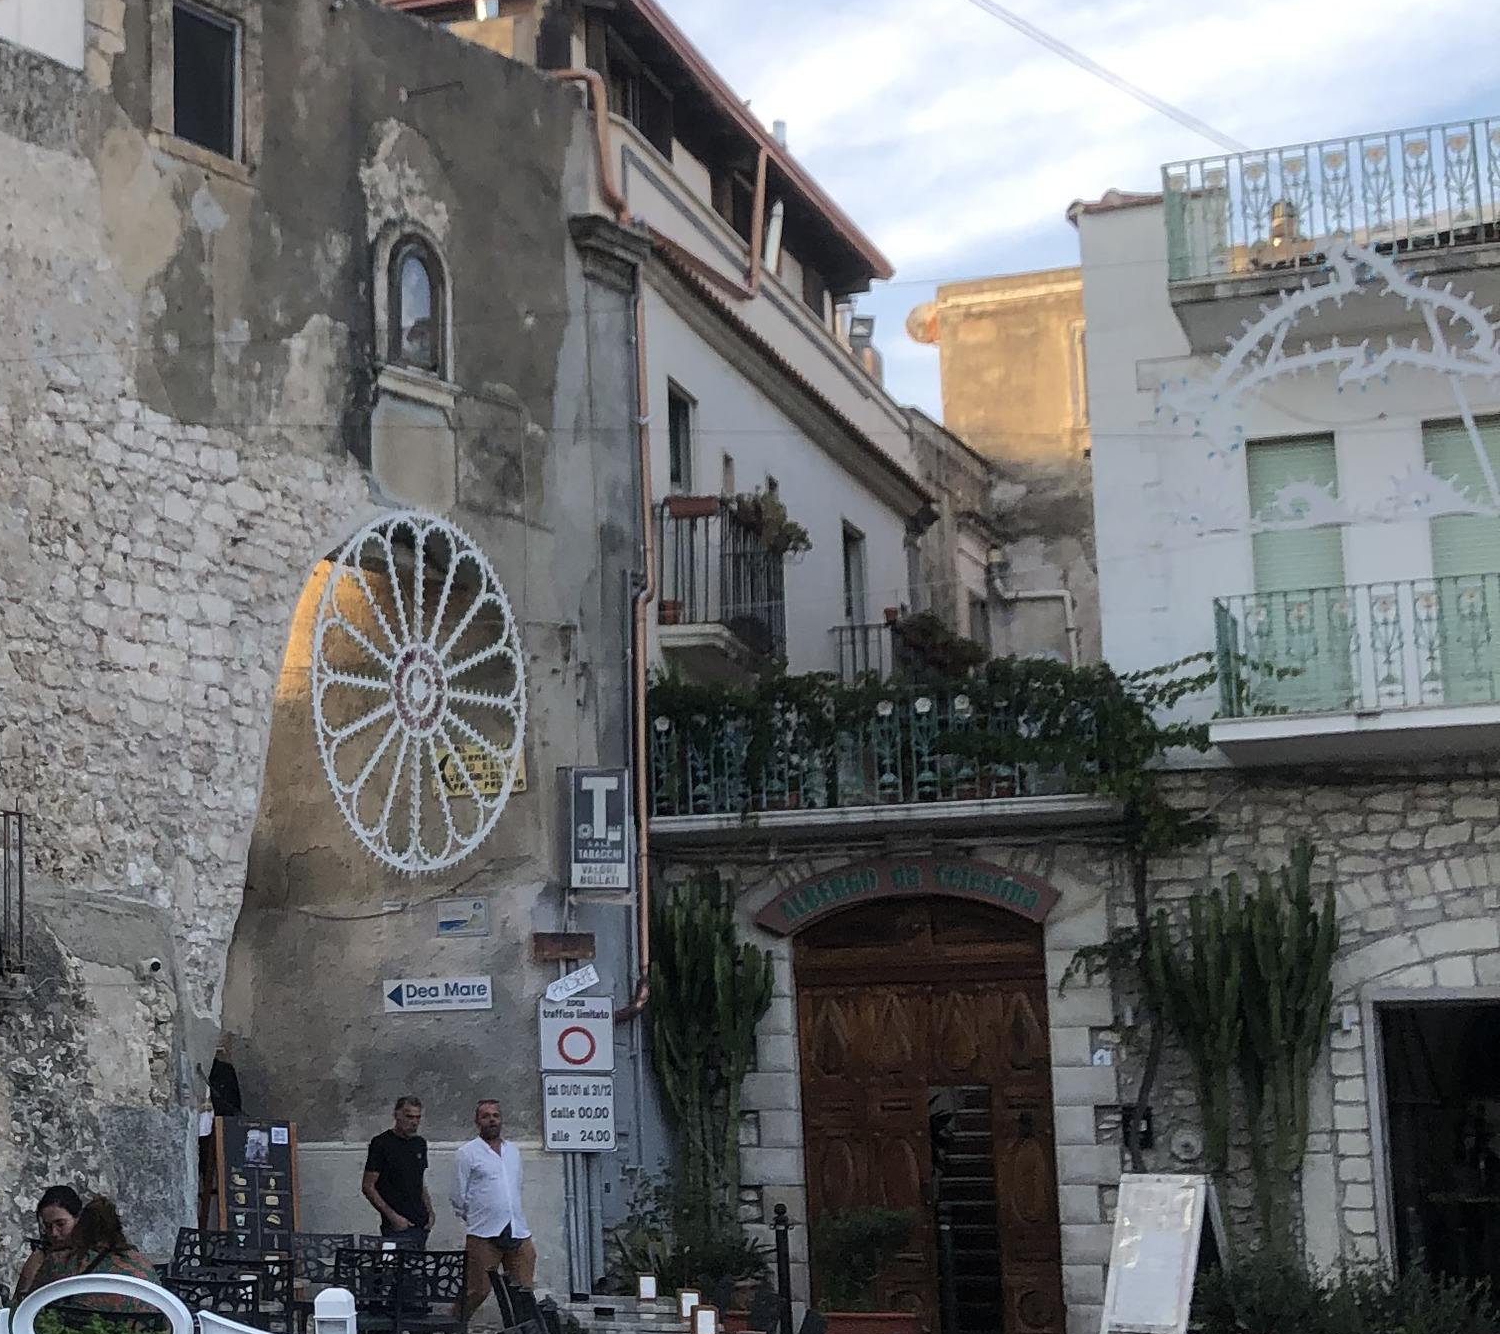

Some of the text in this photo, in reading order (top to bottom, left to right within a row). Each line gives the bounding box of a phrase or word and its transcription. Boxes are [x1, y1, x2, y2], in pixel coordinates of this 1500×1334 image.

[578, 849, 621, 859] TABACCHI
[580, 875, 620, 885] BOLLATI
[406, 982, 487, 998] Dea Mare
[543, 1009, 609, 1019] traffico limitato
[548, 1084, 611, 1096] dal 01/01 al 31/12
[551, 1107, 575, 1118] dalle
[551, 1130, 570, 1141] alle
